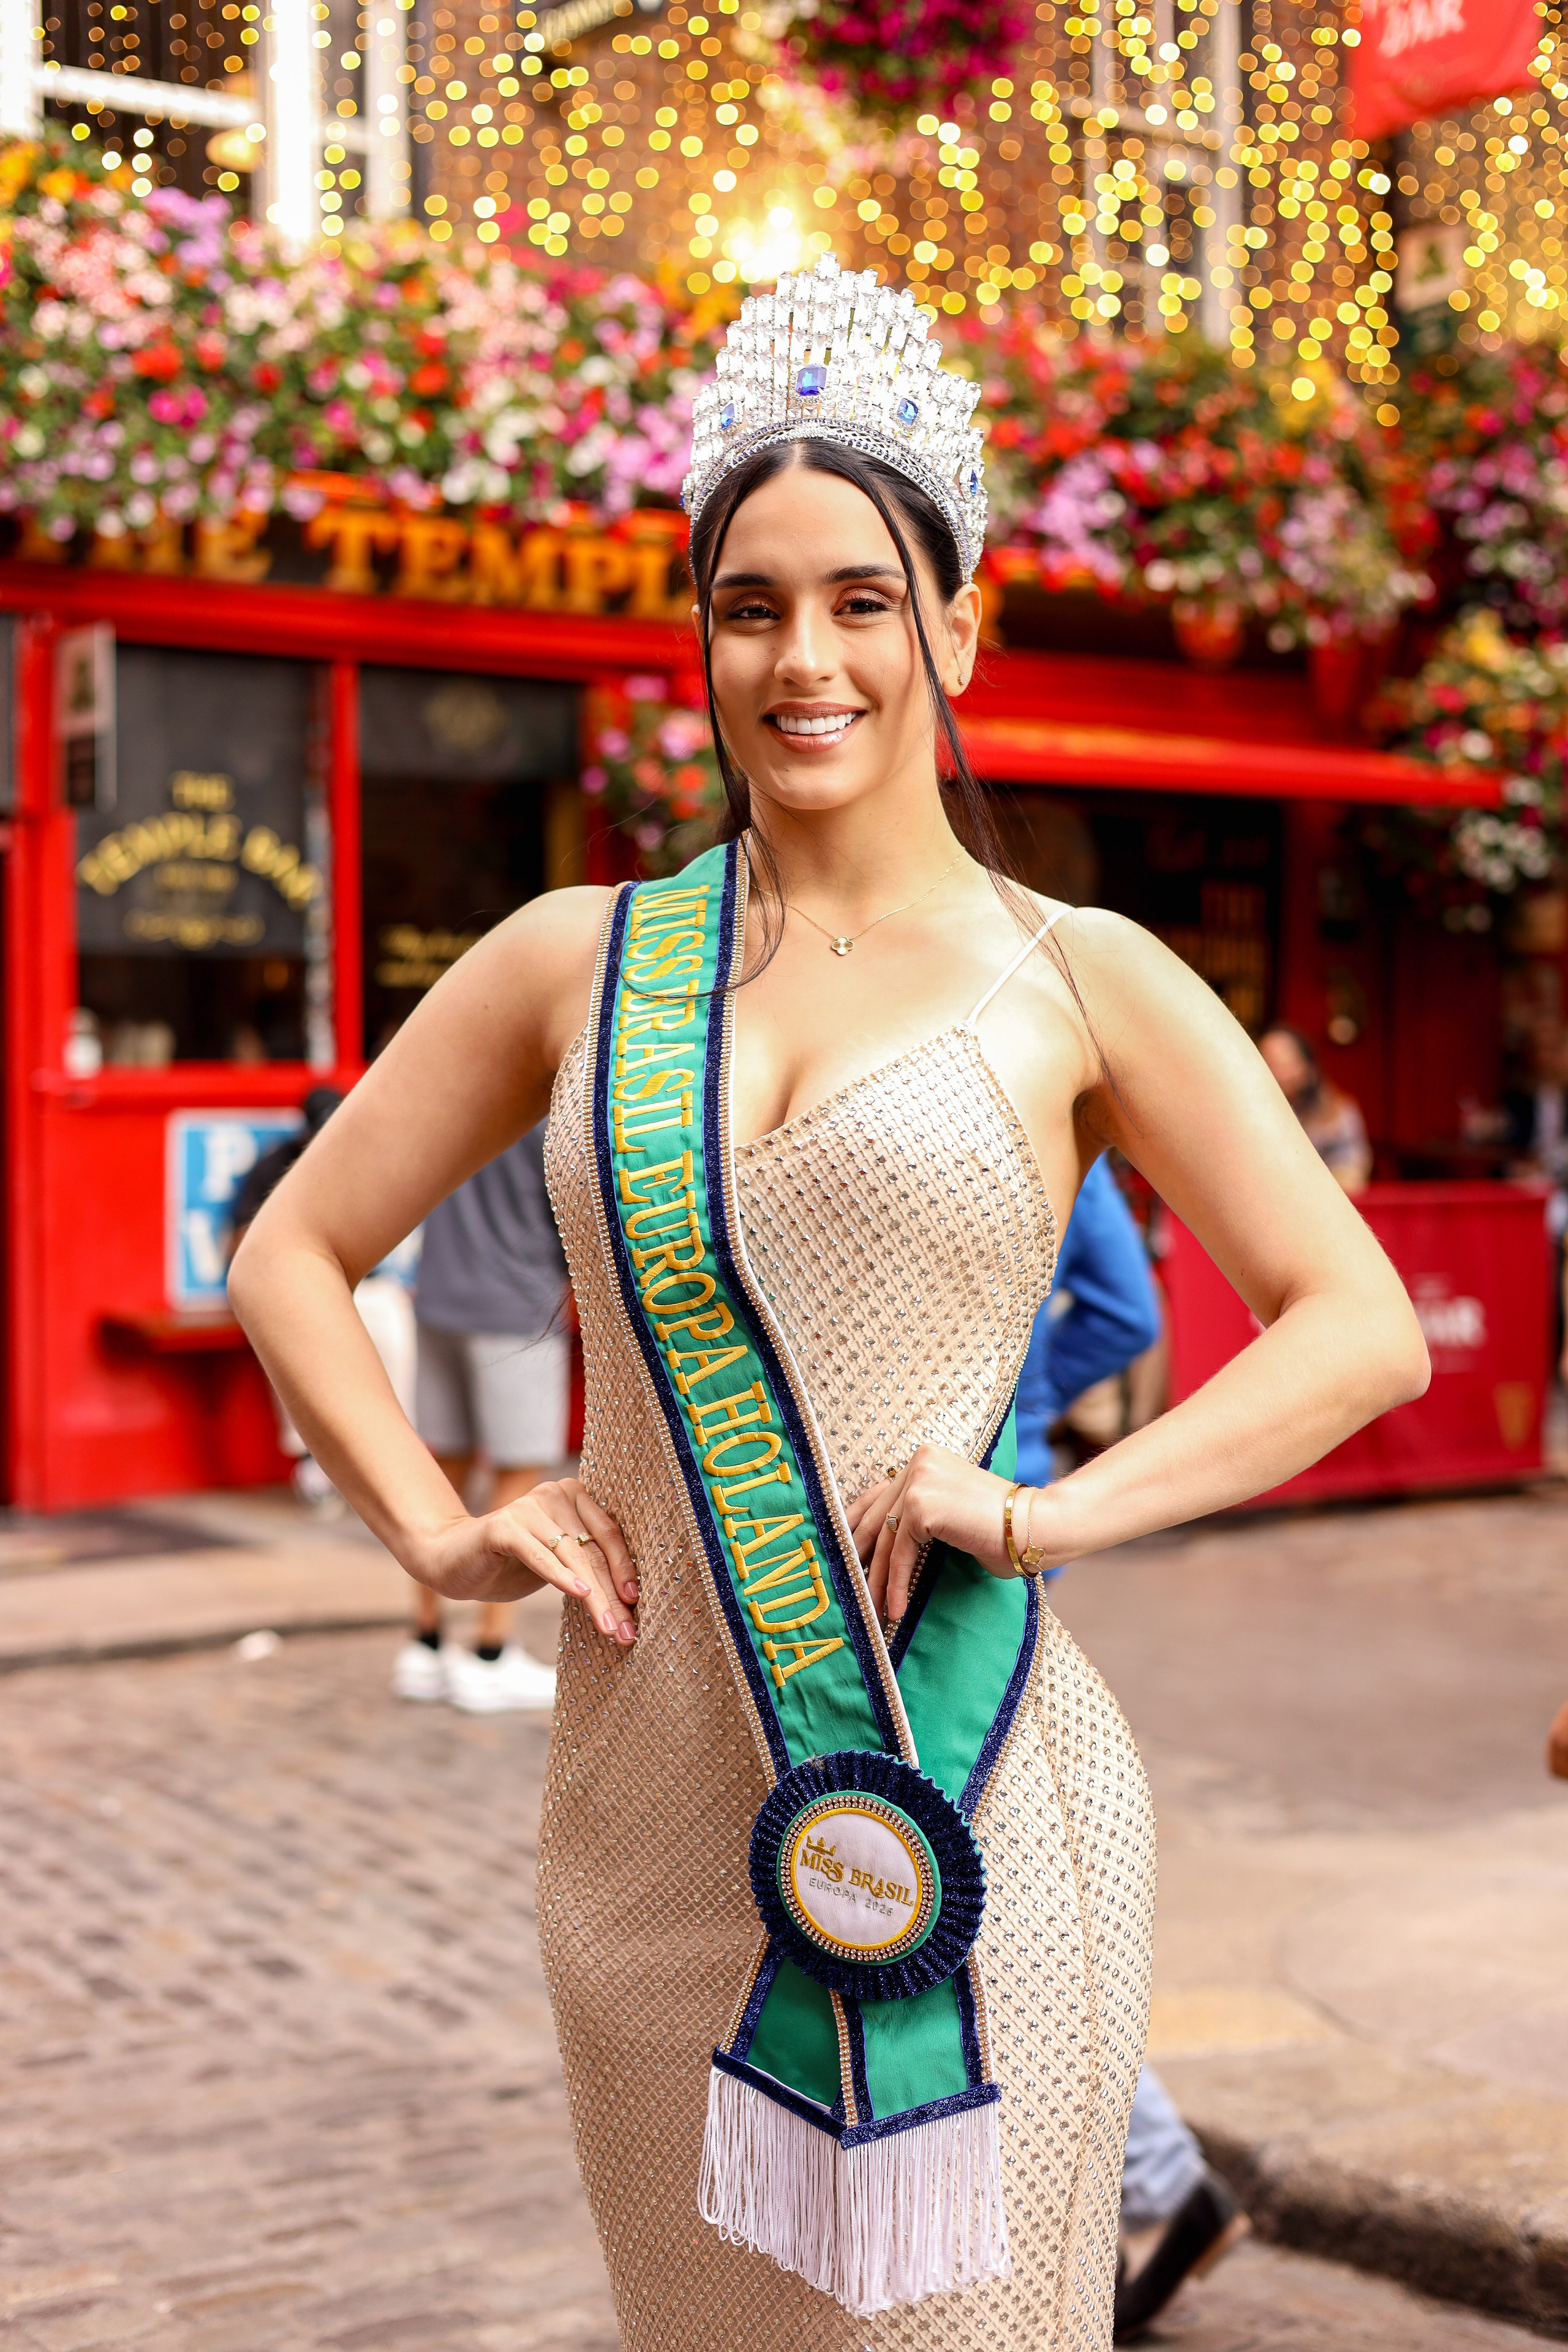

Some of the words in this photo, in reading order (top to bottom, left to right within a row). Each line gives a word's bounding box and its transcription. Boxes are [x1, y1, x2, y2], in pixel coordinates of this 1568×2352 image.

[625, 884, 710, 982] MISS
[612, 979, 700, 1154] BRASIL
[617, 1149, 748, 1396] EUROPA
[685, 1379, 845, 1689] HOLANDA
[799, 1847, 845, 1882] MISS
[848, 1867, 914, 1906] BRASIL
[809, 1875, 858, 1903] EUROPA
